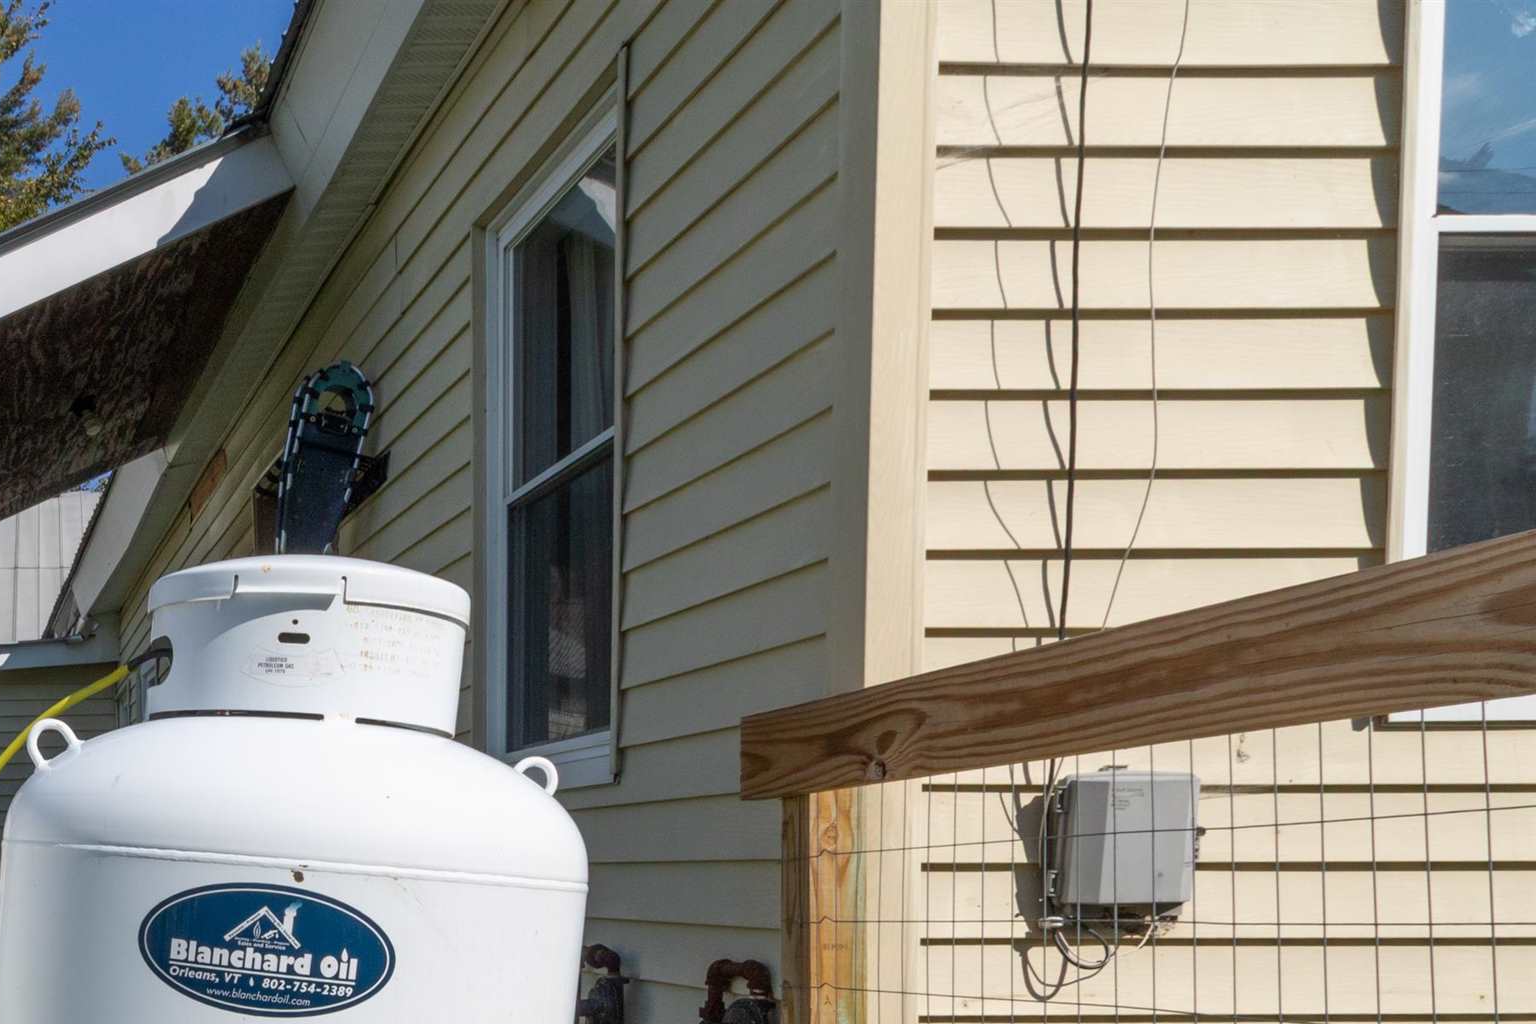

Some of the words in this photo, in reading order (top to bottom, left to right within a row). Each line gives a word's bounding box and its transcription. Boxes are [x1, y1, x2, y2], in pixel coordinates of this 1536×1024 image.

[170, 938, 313, 976] Blanchard
[320, 948, 358, 980] Oil
[169, 966, 219, 984] Orleans,
[224, 973, 242, 985] VT
[262, 978, 354, 998] 802-754-2389
[206, 987, 311, 1007] www.blanchardoil.com
